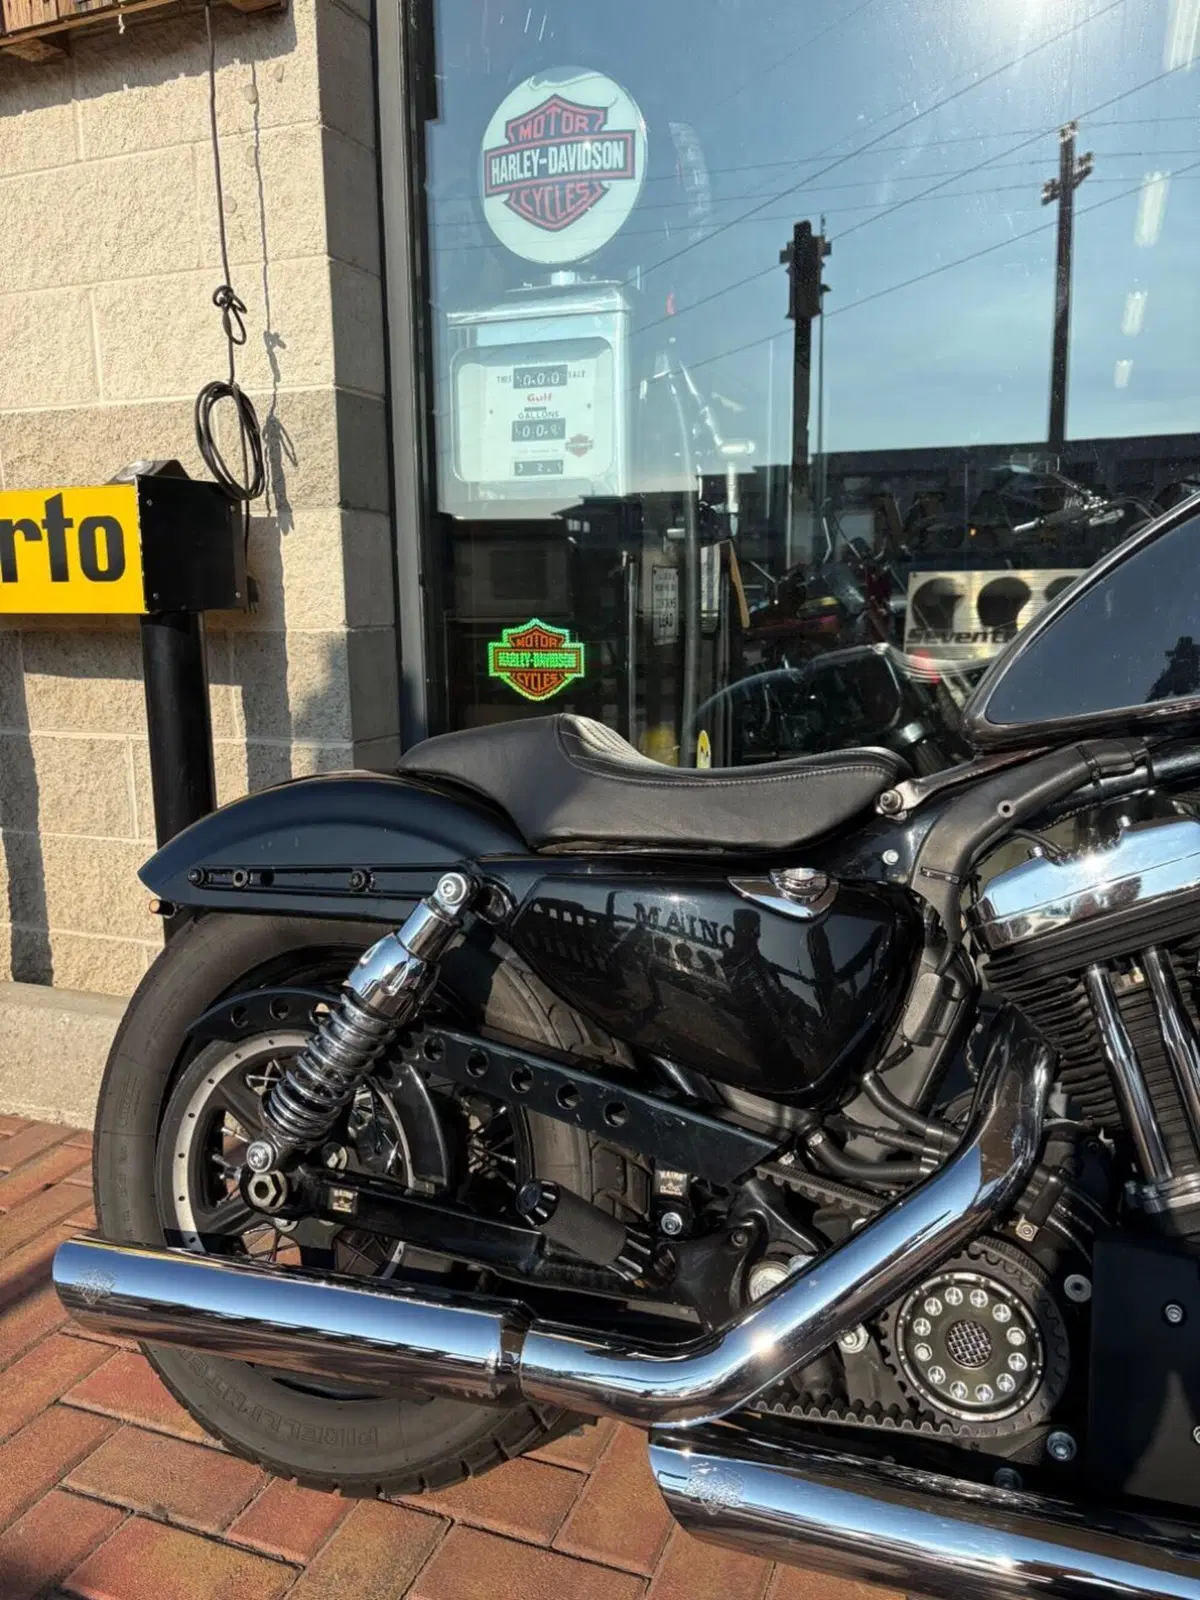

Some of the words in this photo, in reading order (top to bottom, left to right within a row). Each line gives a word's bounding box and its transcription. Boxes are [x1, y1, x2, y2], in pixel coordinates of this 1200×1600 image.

[518, 104, 590, 139] MOTOR
[491, 140, 625, 185] HARLEY-DAVIDSON
[519, 182, 590, 221] CYCLES
[526, 392, 553, 402] Gulf
[518, 410, 560, 420] GALLONS
[0, 492, 126, 583] rto
[516, 631, 558, 648] MOTOR
[515, 672, 558, 691] CYCLES
